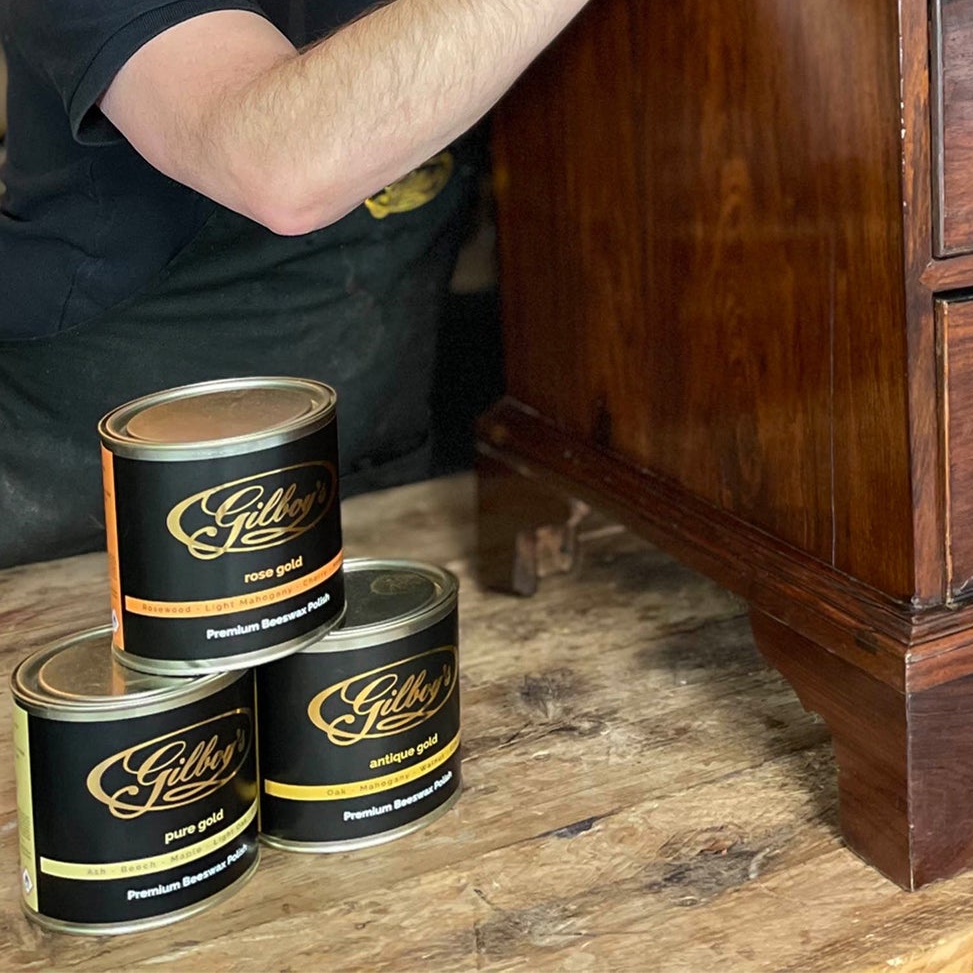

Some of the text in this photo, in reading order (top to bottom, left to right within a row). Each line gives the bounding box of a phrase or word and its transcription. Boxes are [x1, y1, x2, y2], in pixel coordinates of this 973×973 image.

[186, 480, 329, 559] Gilboy's
[244, 555, 304, 583] rose gold
[142, 603, 191, 613] Rosewood
[205, 601, 235, 612] Light
[239, 587, 293, 606] Mahogany
[206, 592, 331, 640] Premium Beeswax Polish
[327, 664, 452, 746] Gilboy's
[369, 747, 415, 769] antique
[416, 732, 438, 756] gold
[110, 728, 246, 819] Gilboy's
[327, 788, 346, 796] Oak
[359, 774, 410, 792] Mahogany
[343, 803, 393, 822] Premium
[393, 785, 434, 810] Beeswax
[164, 824, 196, 845] pure
[197, 808, 224, 833] gold
[87, 868, 106, 876] Ash
[121, 861, 156, 873] Beech
[170, 847, 203, 862] Maple
[127, 843, 248, 901] Premium Beeswax Polish
